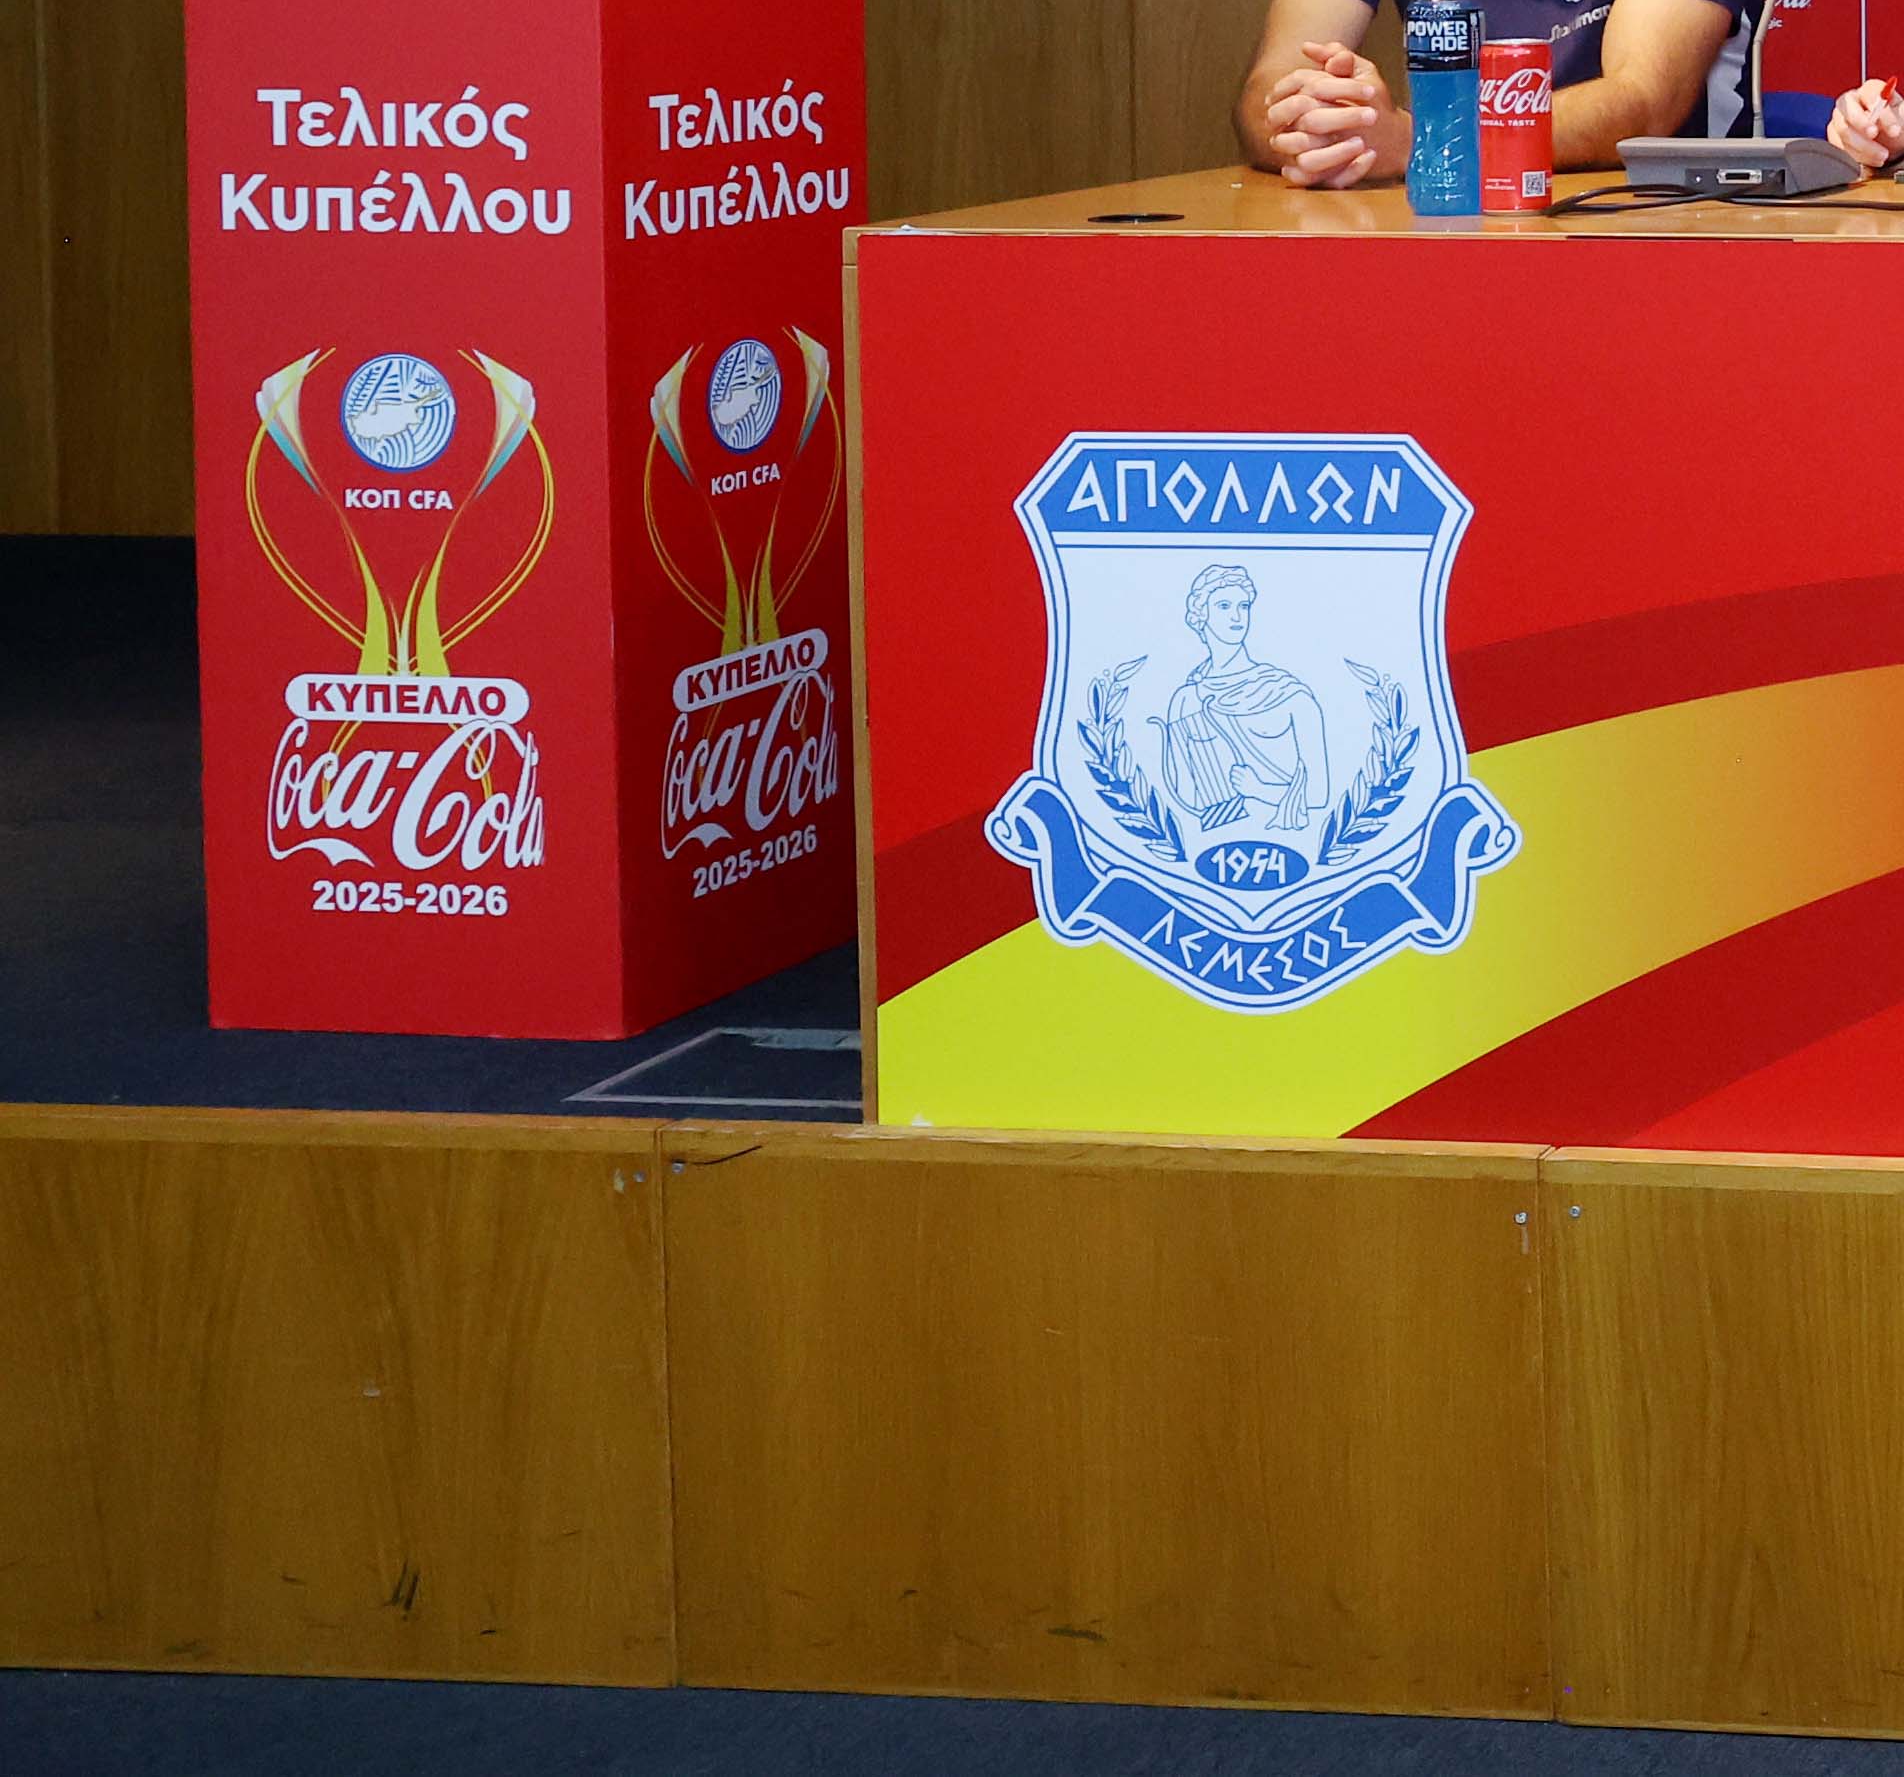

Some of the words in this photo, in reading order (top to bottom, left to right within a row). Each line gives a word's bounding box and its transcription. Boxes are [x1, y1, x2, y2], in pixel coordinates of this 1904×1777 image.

[1408, 21, 1467, 37] POWER
[1431, 37, 1468, 51] ADE
[257, 86, 529, 158] Τελικός
[649, 80, 823, 151] Τελικός
[220, 170, 571, 235] Κυπέλλου
[624, 161, 850, 240] Κυπέλλου
[345, 487, 403, 509] ΚΟΠ
[408, 489, 453, 511] CFA
[711, 469, 748, 497] ΚΟΠ
[752, 463, 781, 489] CFA
[1066, 459, 1402, 525] ΑΠΟΛΛΩΝ
[306, 683, 506, 716] ΚΥΠΕΛΛΟ
[687, 636, 815, 706] ΚΥΠΕΛΛΟ
[267, 719, 544, 871] Coca-Cola
[661, 669, 839, 860] Coca-Cola
[693, 830, 818, 899] 2025-2026
[1211, 848, 1287, 884] 1954
[313, 881, 508, 917] 2025-2026
[1142, 905, 1367, 992] ΛΕΜΕΣΟΣ
